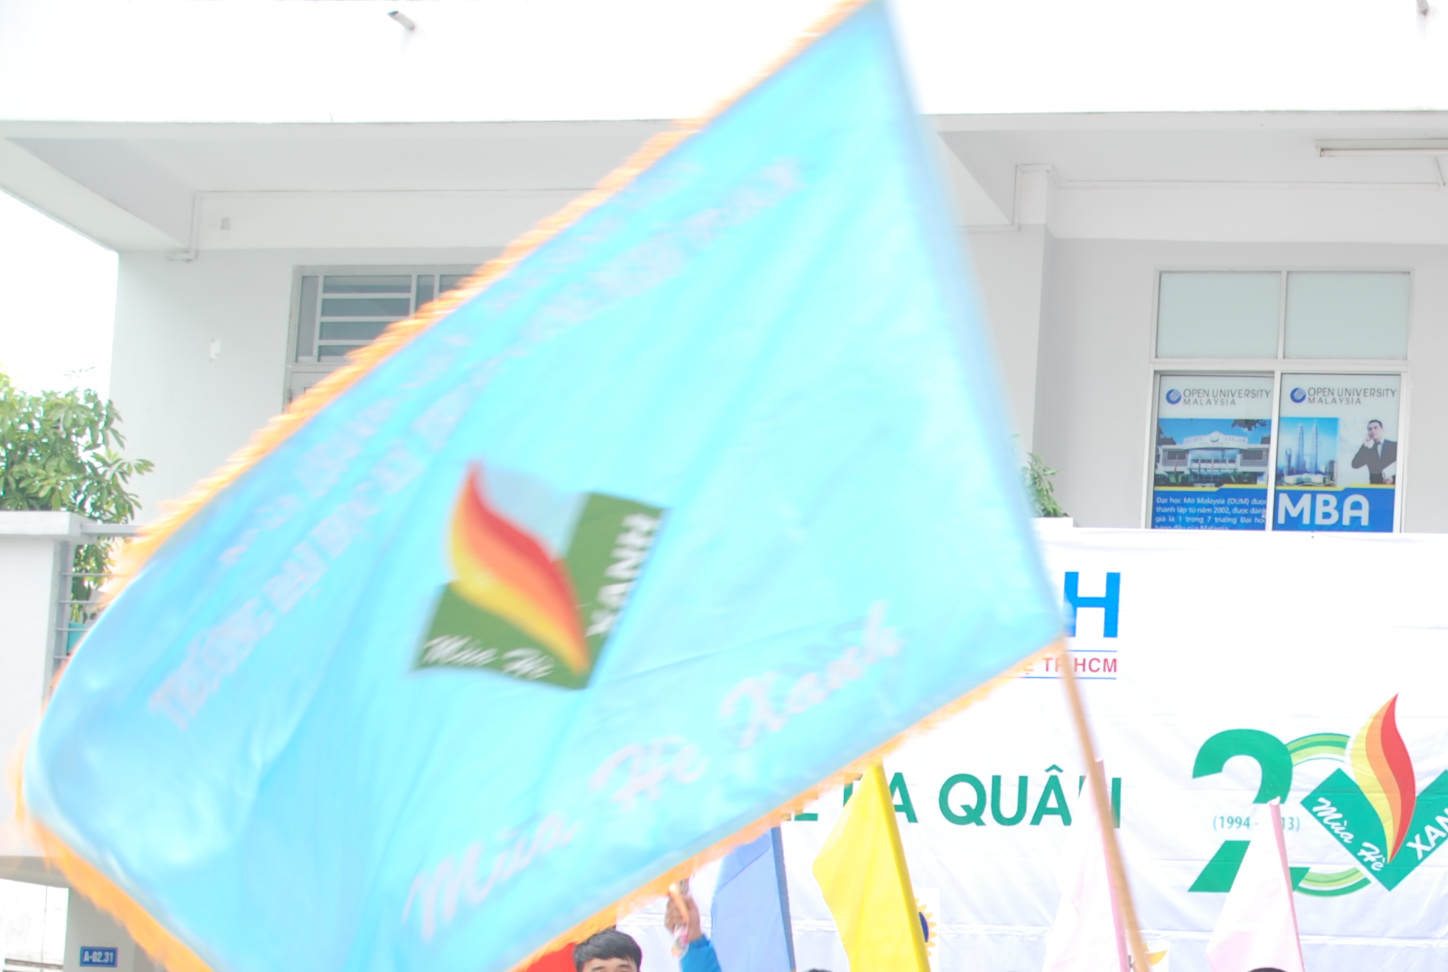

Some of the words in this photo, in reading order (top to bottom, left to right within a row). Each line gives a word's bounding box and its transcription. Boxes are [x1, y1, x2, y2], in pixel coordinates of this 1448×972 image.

[1183, 388, 1212, 398] OPEN
[1213, 389, 1272, 399] UNIVERSITY
[1308, 387, 1336, 398] OPEN
[1337, 388, 1398, 398] UNIVERSITY
[1183, 398, 1237, 406] MALAYSIA
[1308, 398, 1362, 406] MALAYSIA
[1277, 493, 1371, 527] MBA
[1213, 815, 1251, 831] (1994
[1311, 796, 1355, 845] Mùa
[1357, 841, 1387, 872] Hè
[403, 811, 580, 943] Mùa
[83, 950, 114, 963] A-02.31
